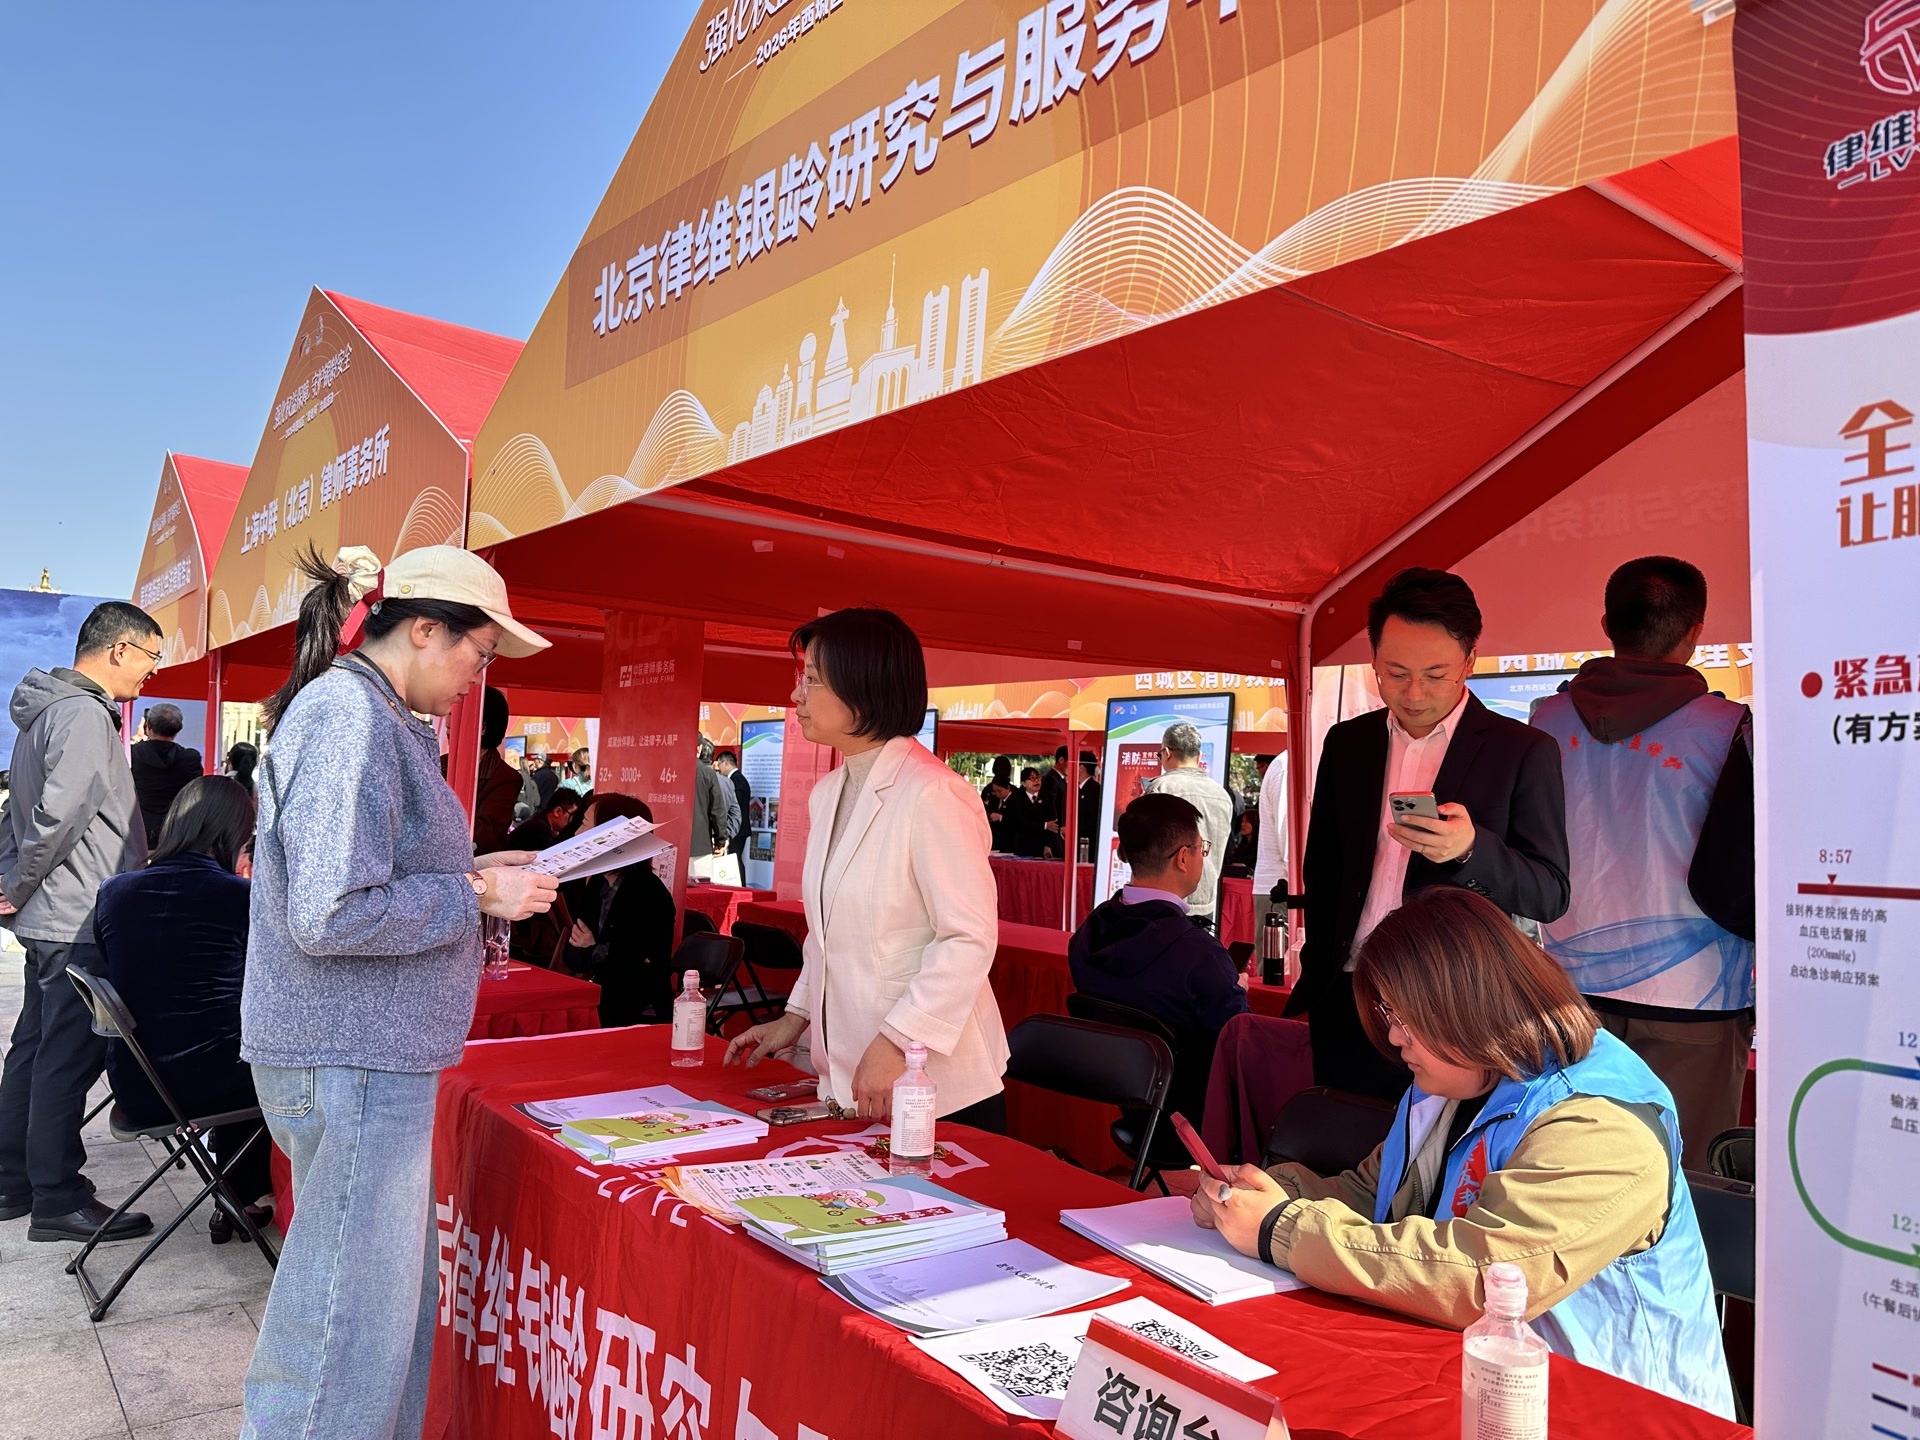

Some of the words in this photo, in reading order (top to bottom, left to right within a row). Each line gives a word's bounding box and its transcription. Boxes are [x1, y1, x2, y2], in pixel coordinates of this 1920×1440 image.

[700, 0, 793, 72] 强化
[1823, 110, 1920, 179] 律维
[592, 0, 1238, 338] 北京律维银龄研究与服务
[1838, 399, 1915, 487] 全
[1833, 653, 1920, 700] 紧急
[620, 767, 641, 782] 3000+
[660, 768, 677, 783] 46+
[1819, 849, 1852, 864] 8:57
[1786, 902, 1888, 923] 接到养老院报告的高
[1799, 924, 1867, 943] 血压电话警报
[1789, 964, 1880, 987] 启动急诊响应预案
[436, 1192, 828, 1440] 律维银龄研究
